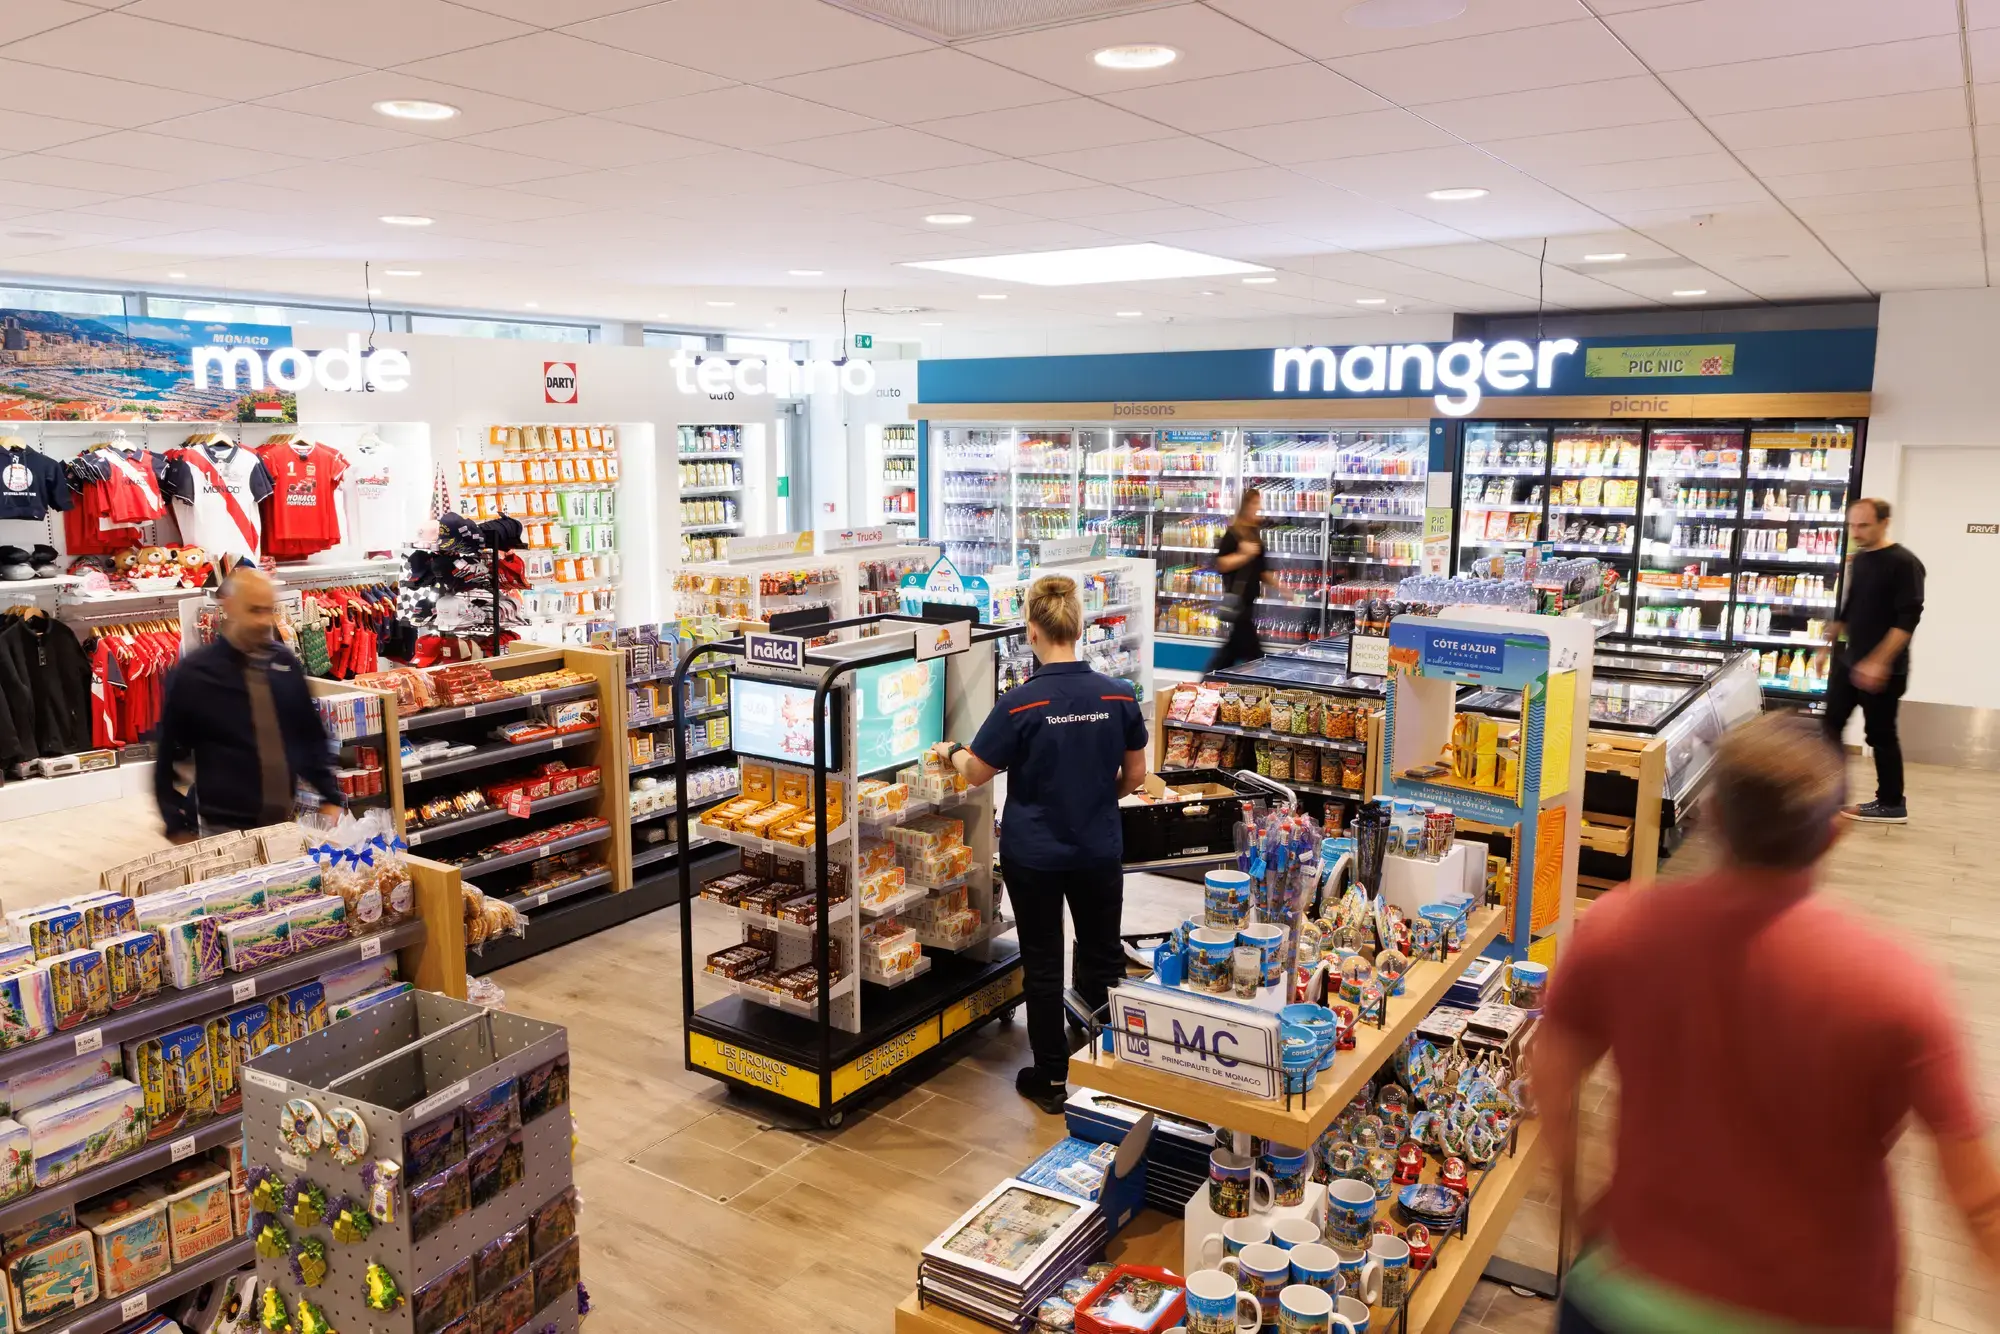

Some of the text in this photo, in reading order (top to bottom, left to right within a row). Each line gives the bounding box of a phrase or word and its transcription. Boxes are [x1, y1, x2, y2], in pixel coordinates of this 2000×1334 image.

[213, 333, 269, 346] MONACO
[192, 333, 411, 392] mode
[1629, 359, 1683, 373] PIC NIC
[669, 349, 876, 396] techno
[1272, 338, 1580, 417] manger
[546, 377, 575, 389] DARTY
[876, 386, 901, 398] auto
[1113, 403, 1175, 416] boissons
[1609, 396, 1669, 416] picnic
[286, 494, 316, 502] MONACO
[1431, 516, 1445, 525] PIC
[1430, 524, 1444, 533] NIC
[1969, 523, 1997, 533] PRIVÉ
[1432, 638, 1497, 655] CÔTE d'AZUR
[1456, 794, 1473, 802] CHEZ
[1462, 800, 1479, 809] CÔTE
[1480, 803, 1505, 814] D'AZUR
[303, 988, 321, 999] NICE
[245, 1010, 265, 1022] NICE
[179, 1032, 201, 1045] NICE
[1128, 1037, 1148, 1054] MC
[1172, 1019, 1239, 1068] MC
[856, 1028, 917, 1071] LES PROMOS
[717, 1041, 788, 1076] LES PROMOS
[864, 1065, 878, 1081] DU
[880, 1050, 905, 1072] MOIS
[726, 1060, 743, 1074] DU
[744, 1066, 773, 1085] MOIS
[1161, 1055, 1262, 1087] PRINCIPAUTE DE MONACO
[47, 1242, 83, 1267] NICE
